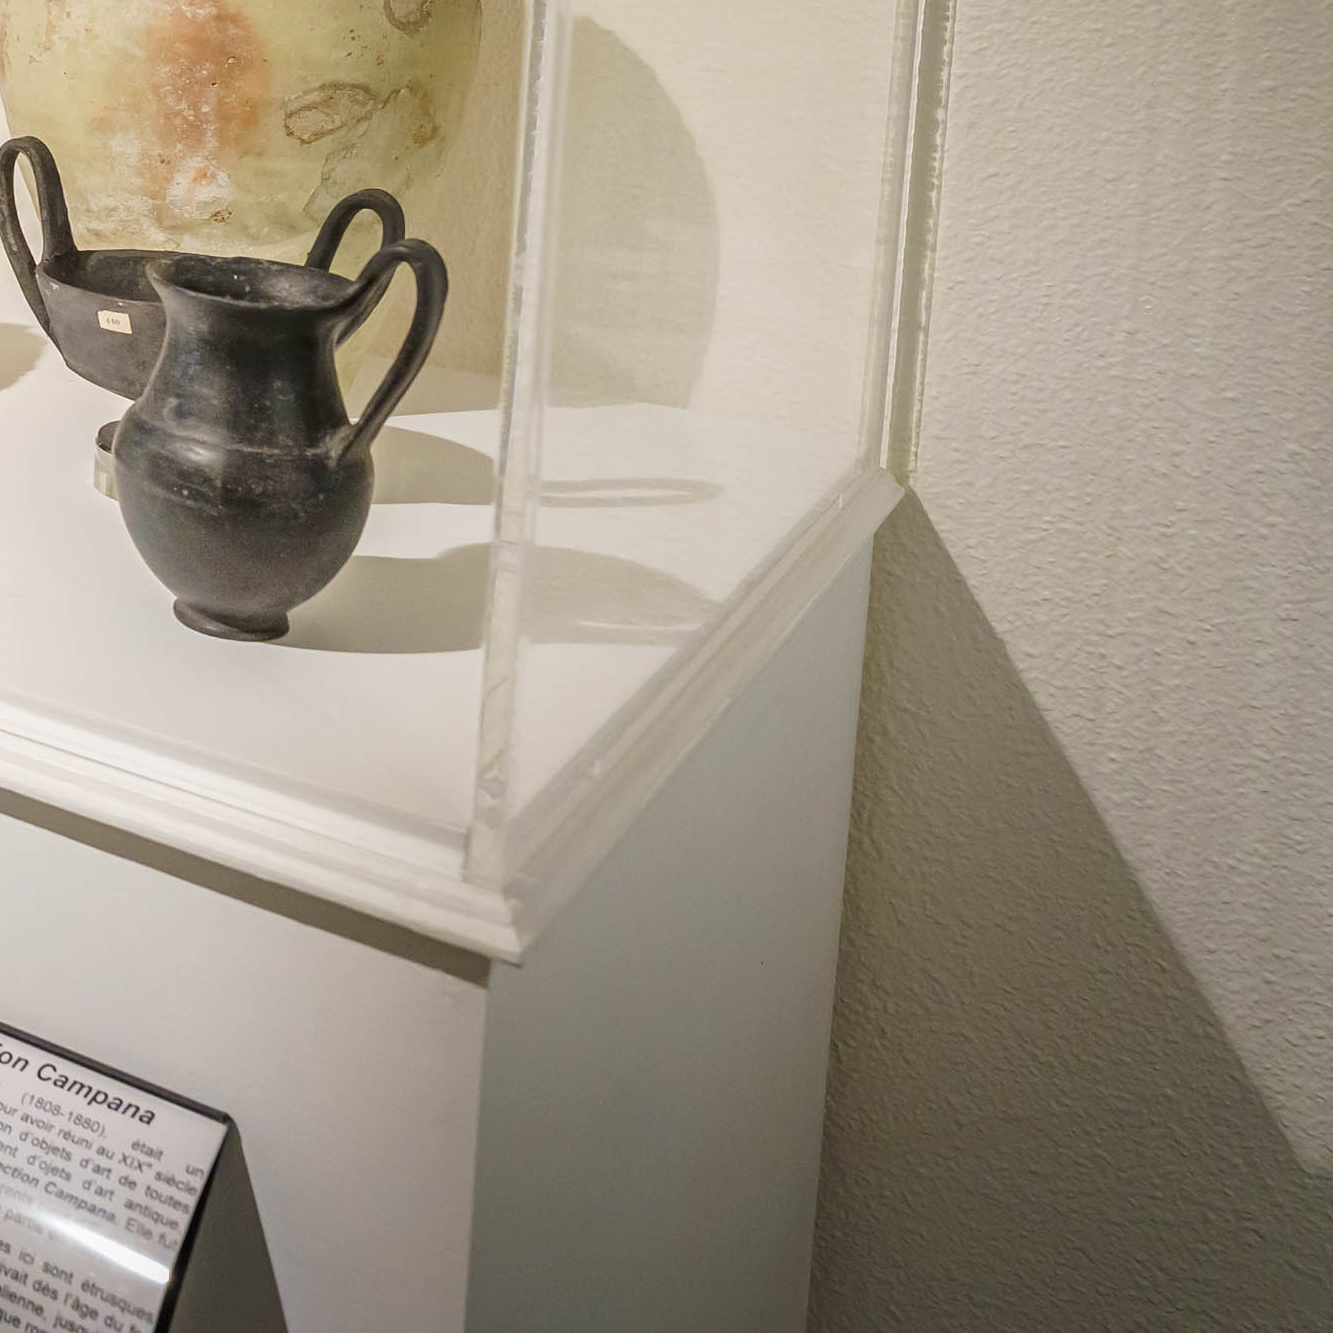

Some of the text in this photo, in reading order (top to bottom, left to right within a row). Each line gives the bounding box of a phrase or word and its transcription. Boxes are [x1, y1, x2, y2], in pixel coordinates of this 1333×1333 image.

[36, 1063, 156, 1126] Campana
[20, 1112, 55, 1132] avoir
[57, 1128, 93, 1150] réuni
[96, 1145, 114, 1160] au
[154, 1170, 197, 1196] siècle
[131, 1140, 164, 1161] était
[185, 1164, 205, 1178] un
[118, 1174, 137, 1190] de
[145, 1186, 190, 1214] toutes
[125, 1216, 153, 1240] Elle
[19, 1249, 34, 1265] ici
[42, 1261, 74, 1285] sont
[81, 1277, 153, 1324] étrusques
[32, 1279, 58, 1301] dès
[103, 1314, 124, 1333] du
